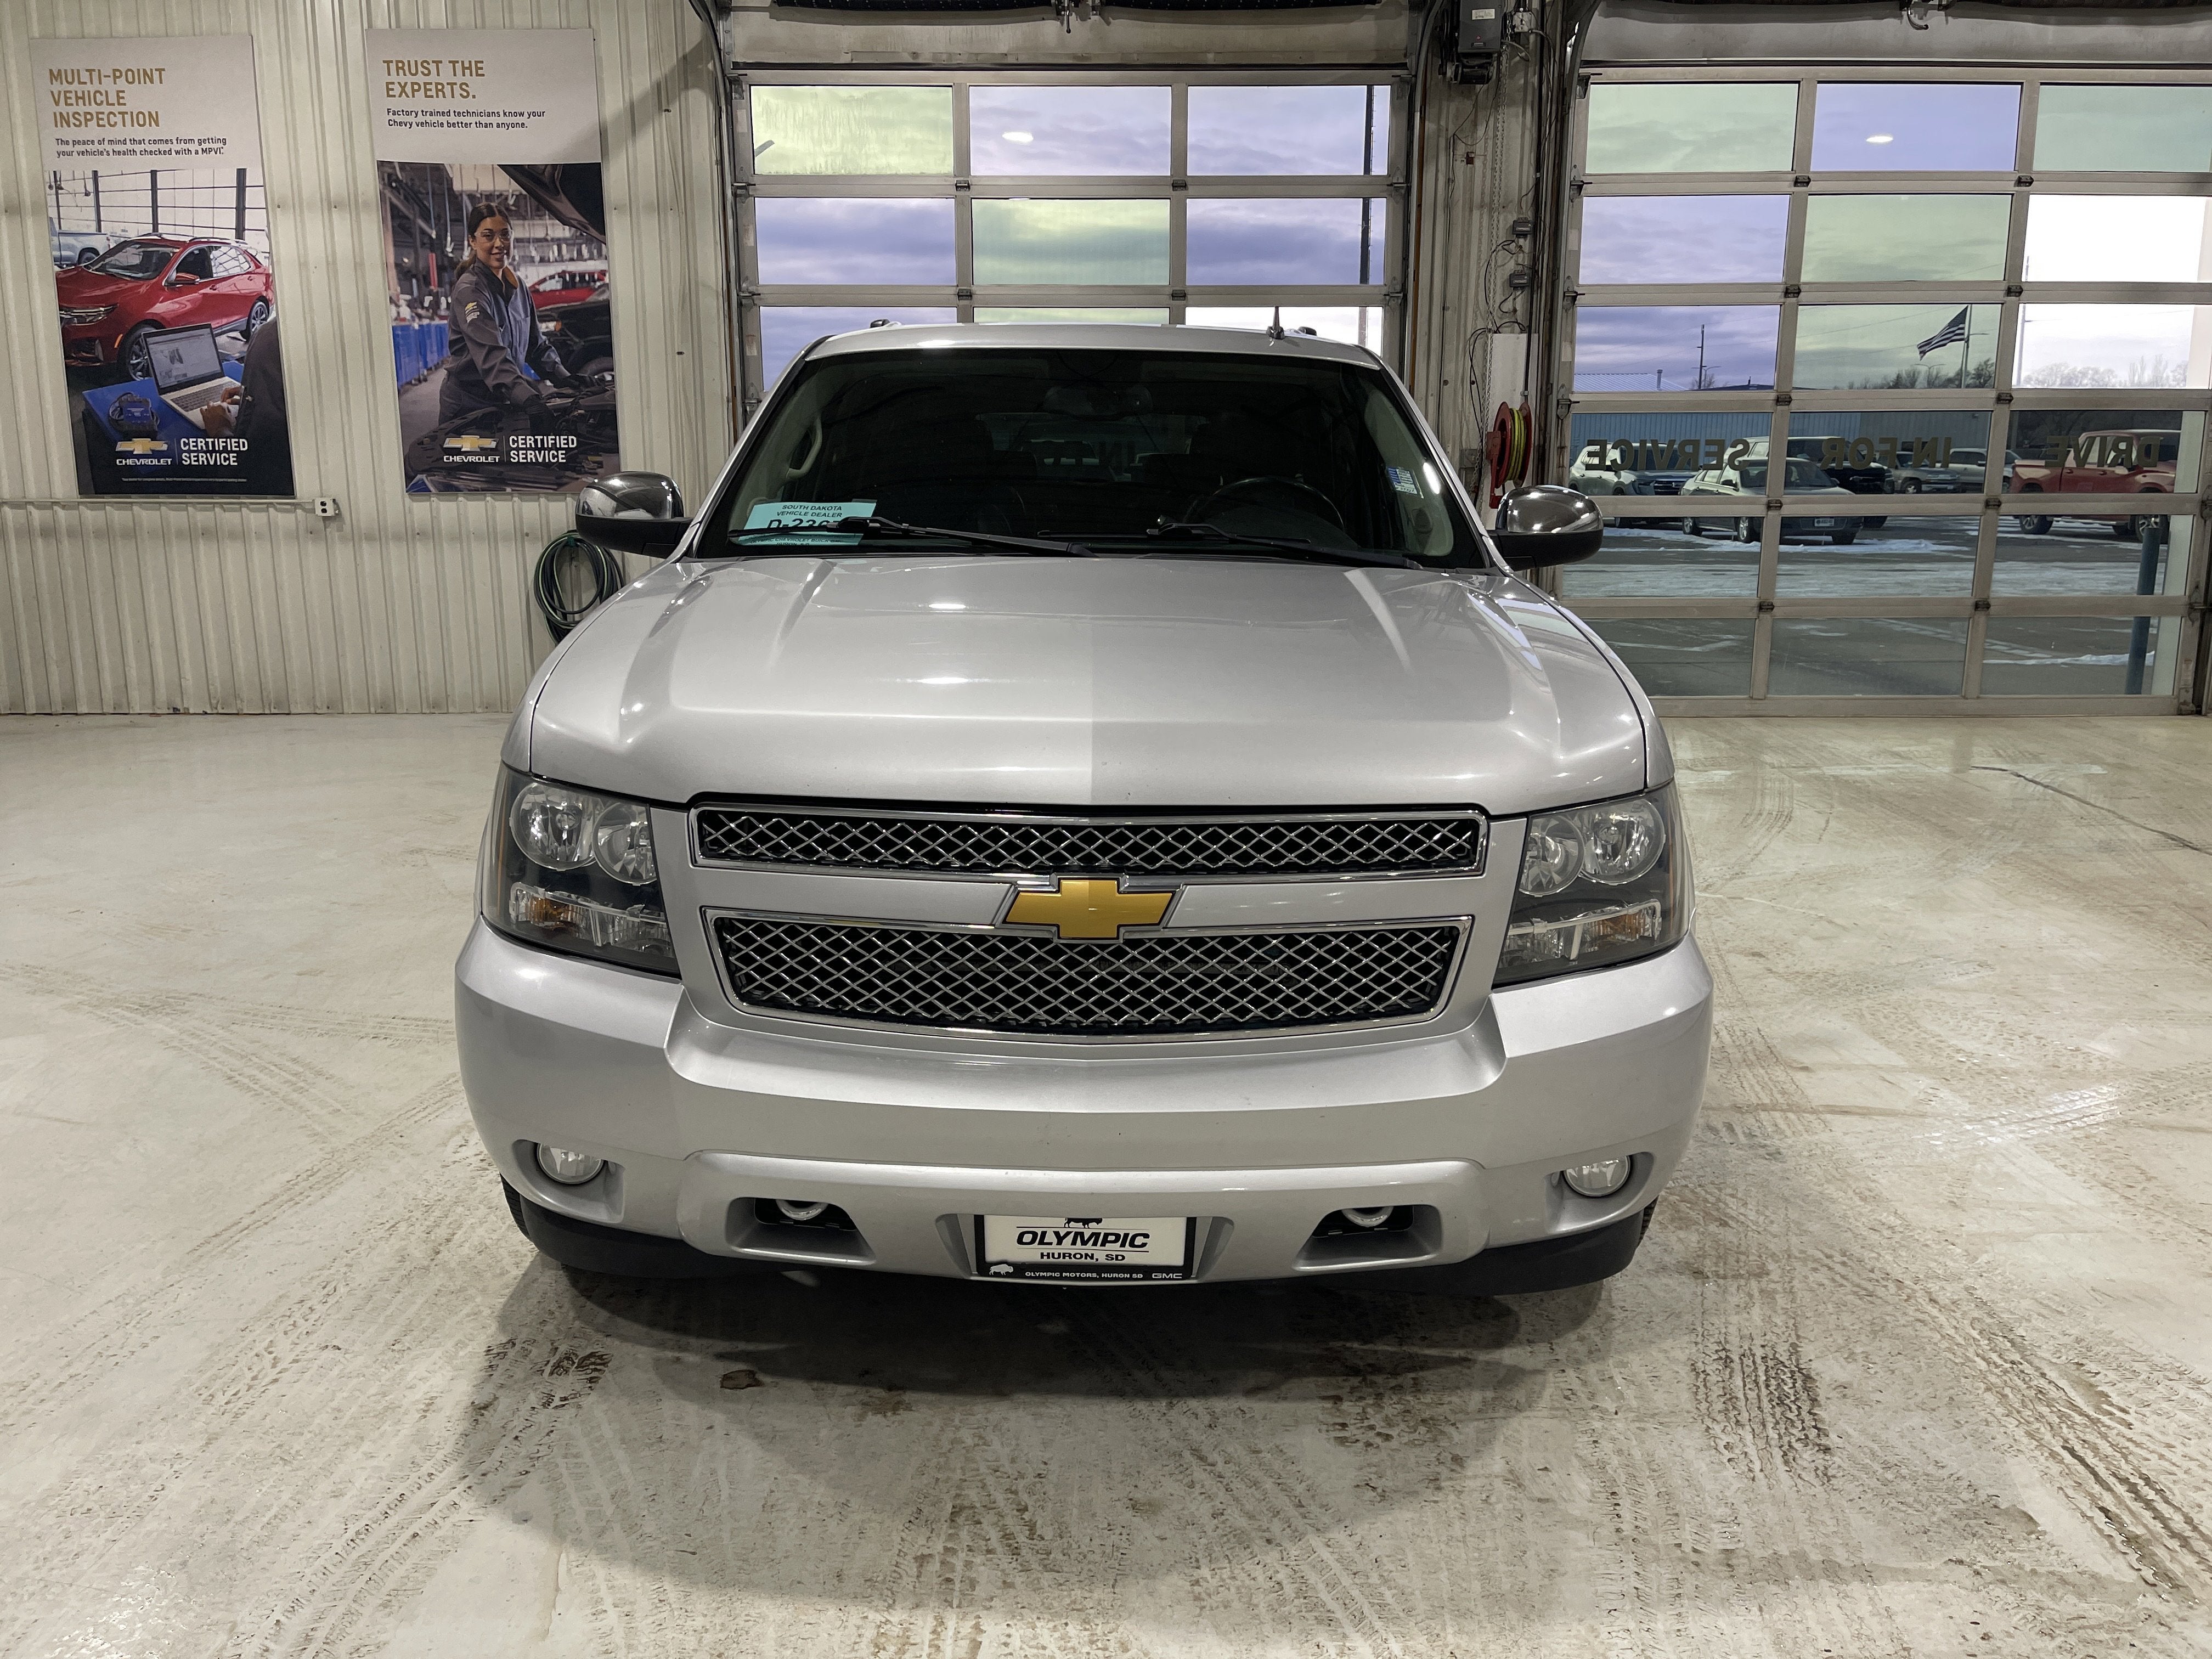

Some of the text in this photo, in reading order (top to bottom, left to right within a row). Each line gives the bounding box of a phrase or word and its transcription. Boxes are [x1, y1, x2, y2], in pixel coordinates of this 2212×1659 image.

[382, 60, 486, 77] TRUST THE
[49, 68, 166, 85] MULTI-POINT
[385, 82, 476, 99] EXPERTS.
[50, 89, 126, 106] VEHICLE
[53, 111, 160, 128] INSPECTION
[387, 108, 545, 119] Factory trained technicians know your
[388, 119, 413, 129] Chevy
[447, 120, 472, 128] better
[475, 120, 493, 128] than
[496, 122, 528, 130] anyone.
[72, 139, 95, 148] peace
[198, 137, 227, 146] getting
[180, 438, 248, 451] CERTIFIED
[509, 436, 577, 448] CERTIFIED
[182, 453, 238, 465] SERVICE
[510, 450, 566, 463] SERVICE
[1017, 1231, 1150, 1249] OLYMPIC
[1040, 1252, 1099, 1262] HURON,
